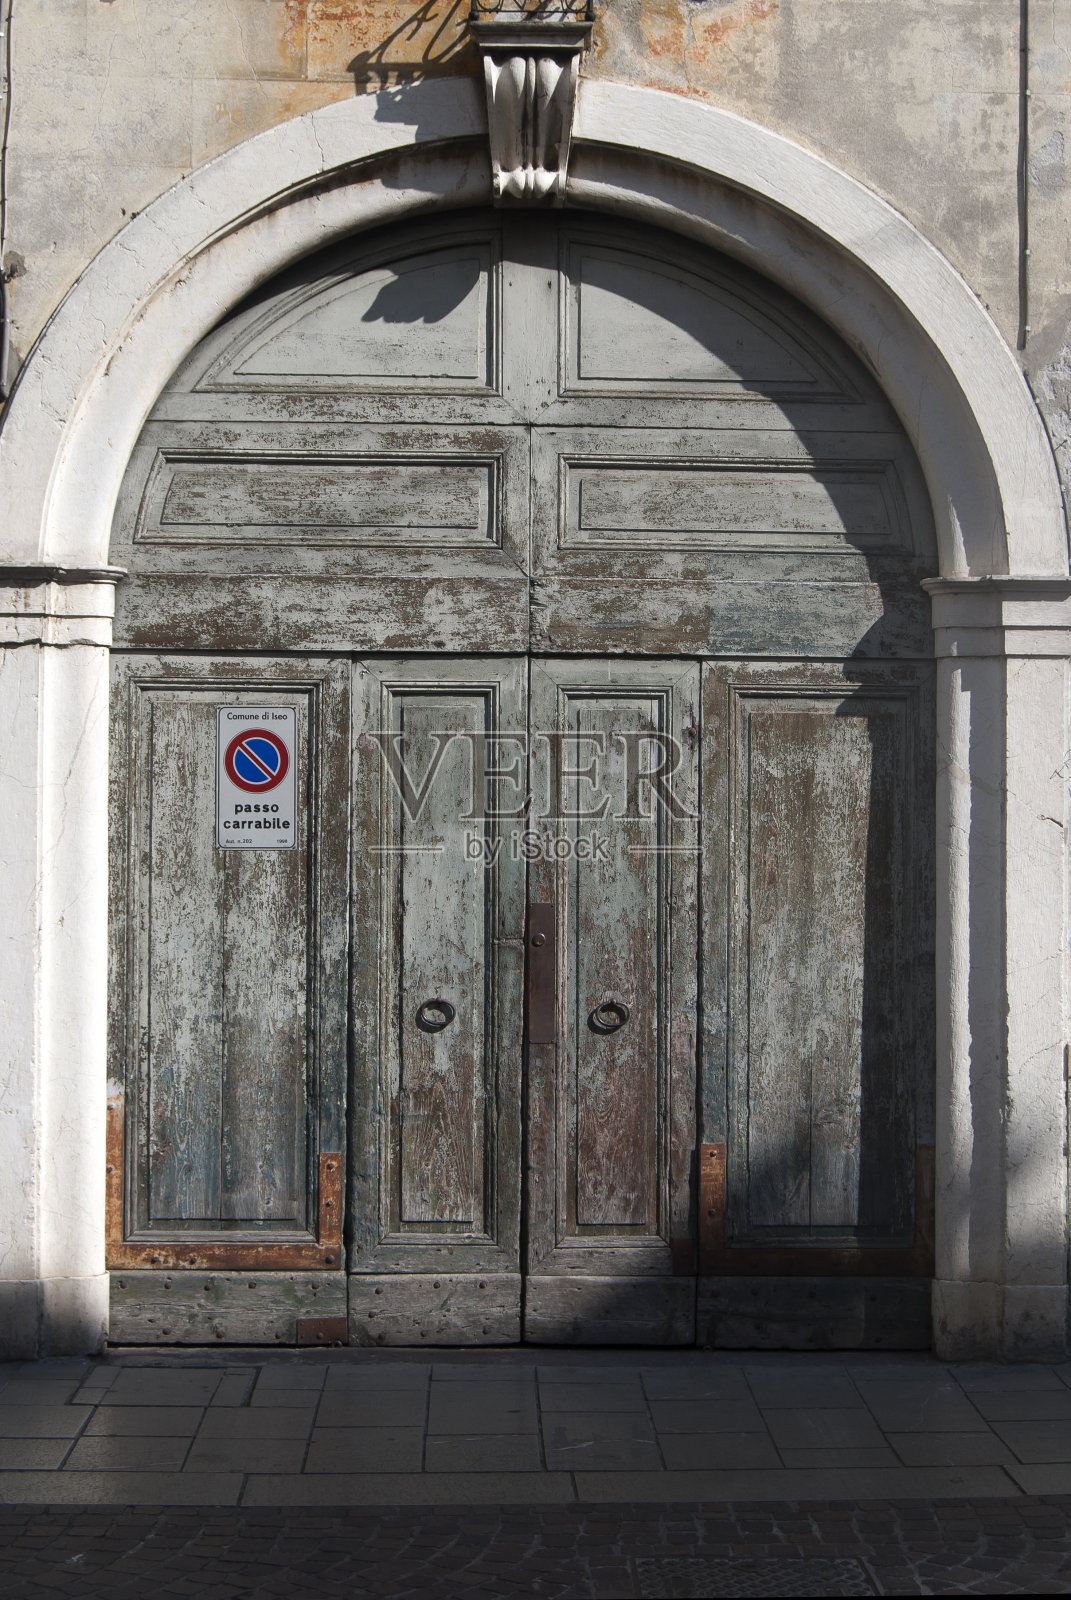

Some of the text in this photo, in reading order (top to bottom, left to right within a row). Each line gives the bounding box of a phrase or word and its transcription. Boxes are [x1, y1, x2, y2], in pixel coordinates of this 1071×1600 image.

[227, 711, 288, 720] Comune di Iseo
[234, 804, 279, 815] passo
[223, 818, 290, 829] carrabile
